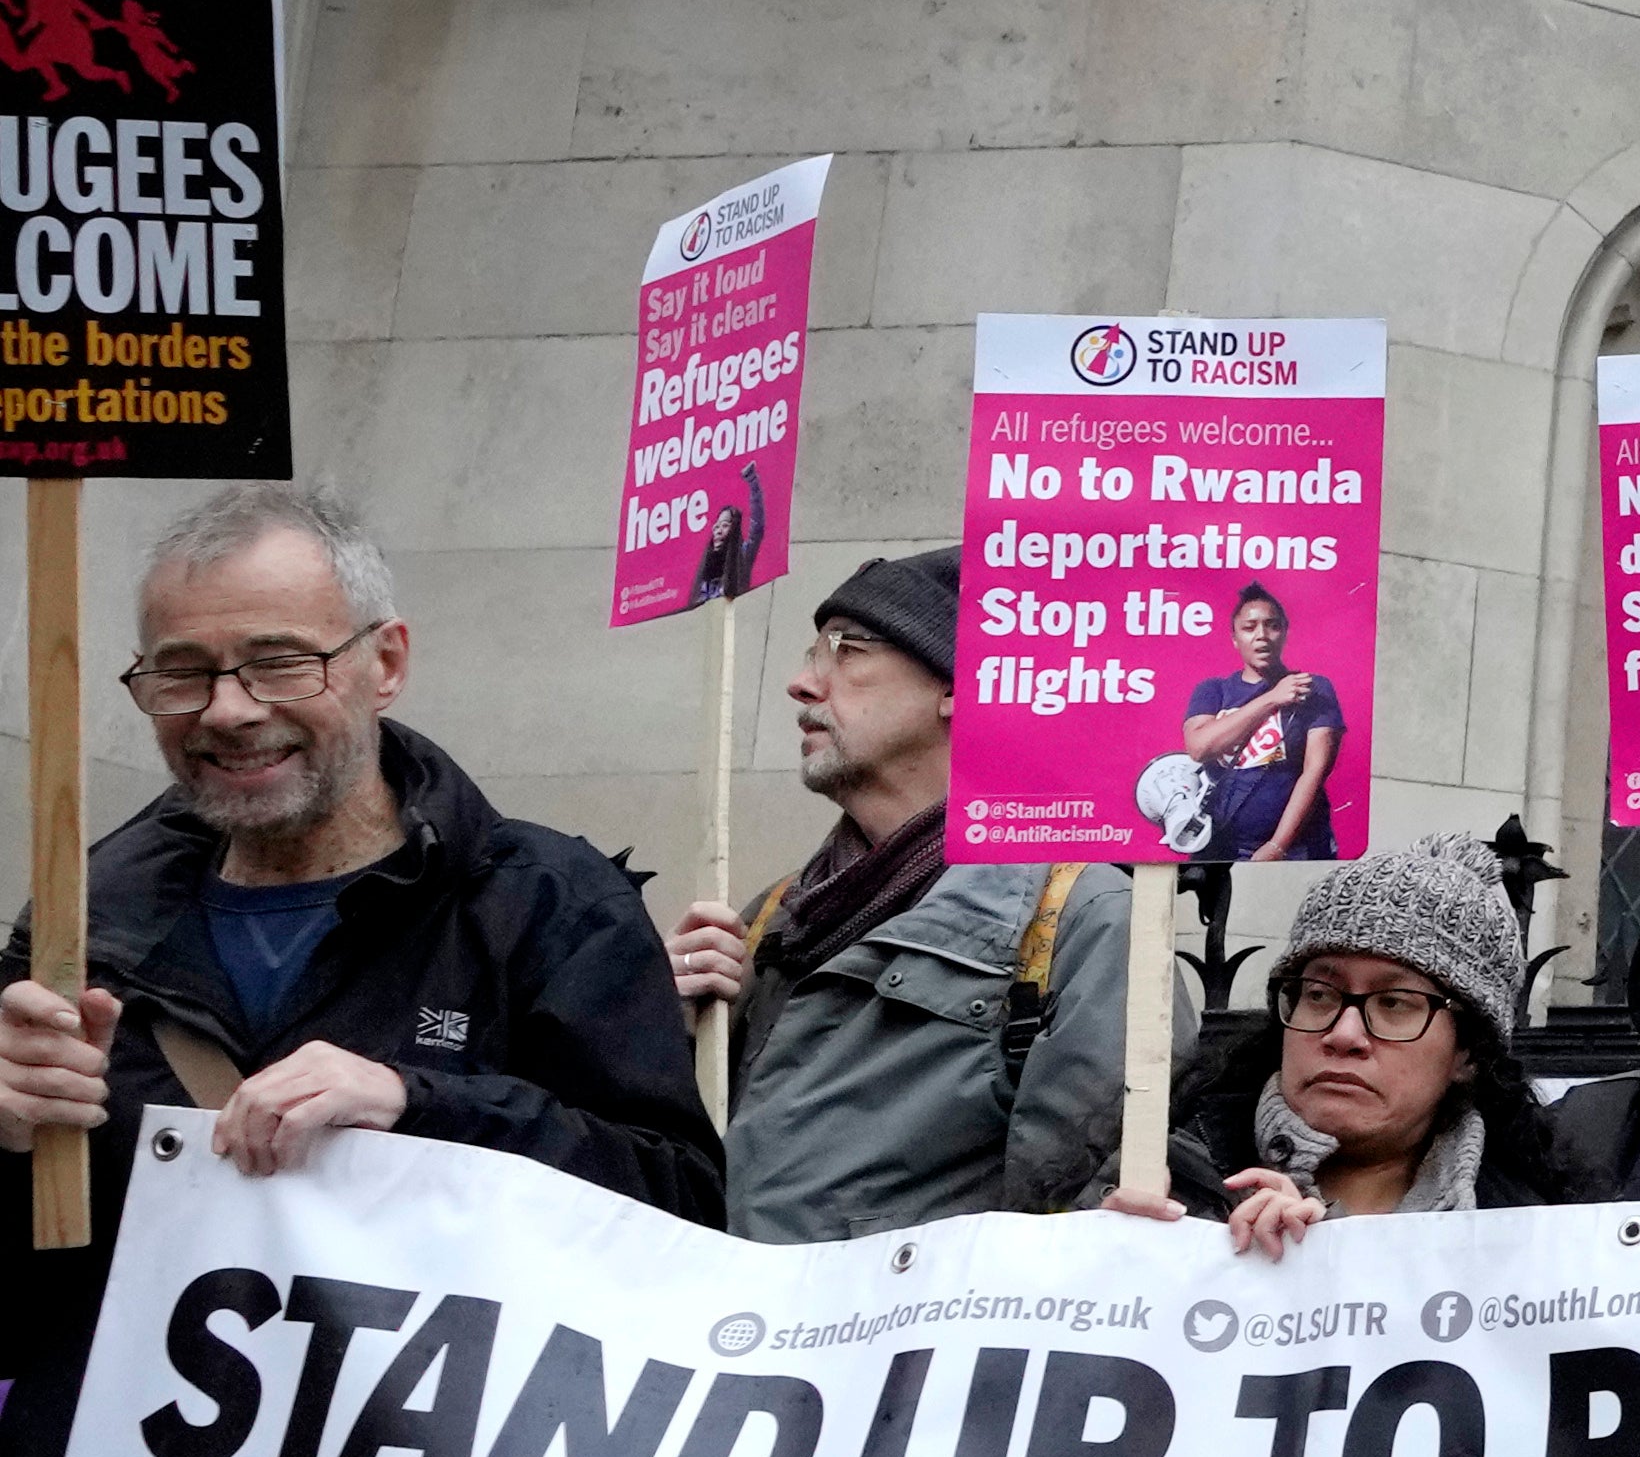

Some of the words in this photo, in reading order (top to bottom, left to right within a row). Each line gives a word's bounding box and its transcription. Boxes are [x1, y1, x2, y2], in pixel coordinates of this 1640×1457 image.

[0, 319, 68, 366] the
[86, 320, 251, 369] borders
[1148, 330, 1237, 356] STAND
[1249, 332, 1285, 356] UP
[639, 328, 799, 426] Refugees
[1147, 359, 1181, 382] TO
[1192, 360, 1297, 385] RACISM
[635, 398, 787, 487] welcome
[991, 412, 1028, 441] All
[1041, 413, 1167, 450] refugees
[989, 454, 1061, 499] No
[1079, 457, 1133, 500] to
[1151, 455, 1361, 504] Rwanda
[625, 490, 708, 552] here
[984, 520, 1337, 579] deportations
[978, 588, 1106, 647] Stop
[1124, 589, 1213, 636] the
[976, 657, 1155, 715] flights
[987, 824, 1133, 845] @AntiRacismDay
[989, 799, 1095, 821] @StandUTR
[769, 1287, 1153, 1356] standuptoracism.org.uk
[1245, 1302, 1387, 1346] @SLSUTR
